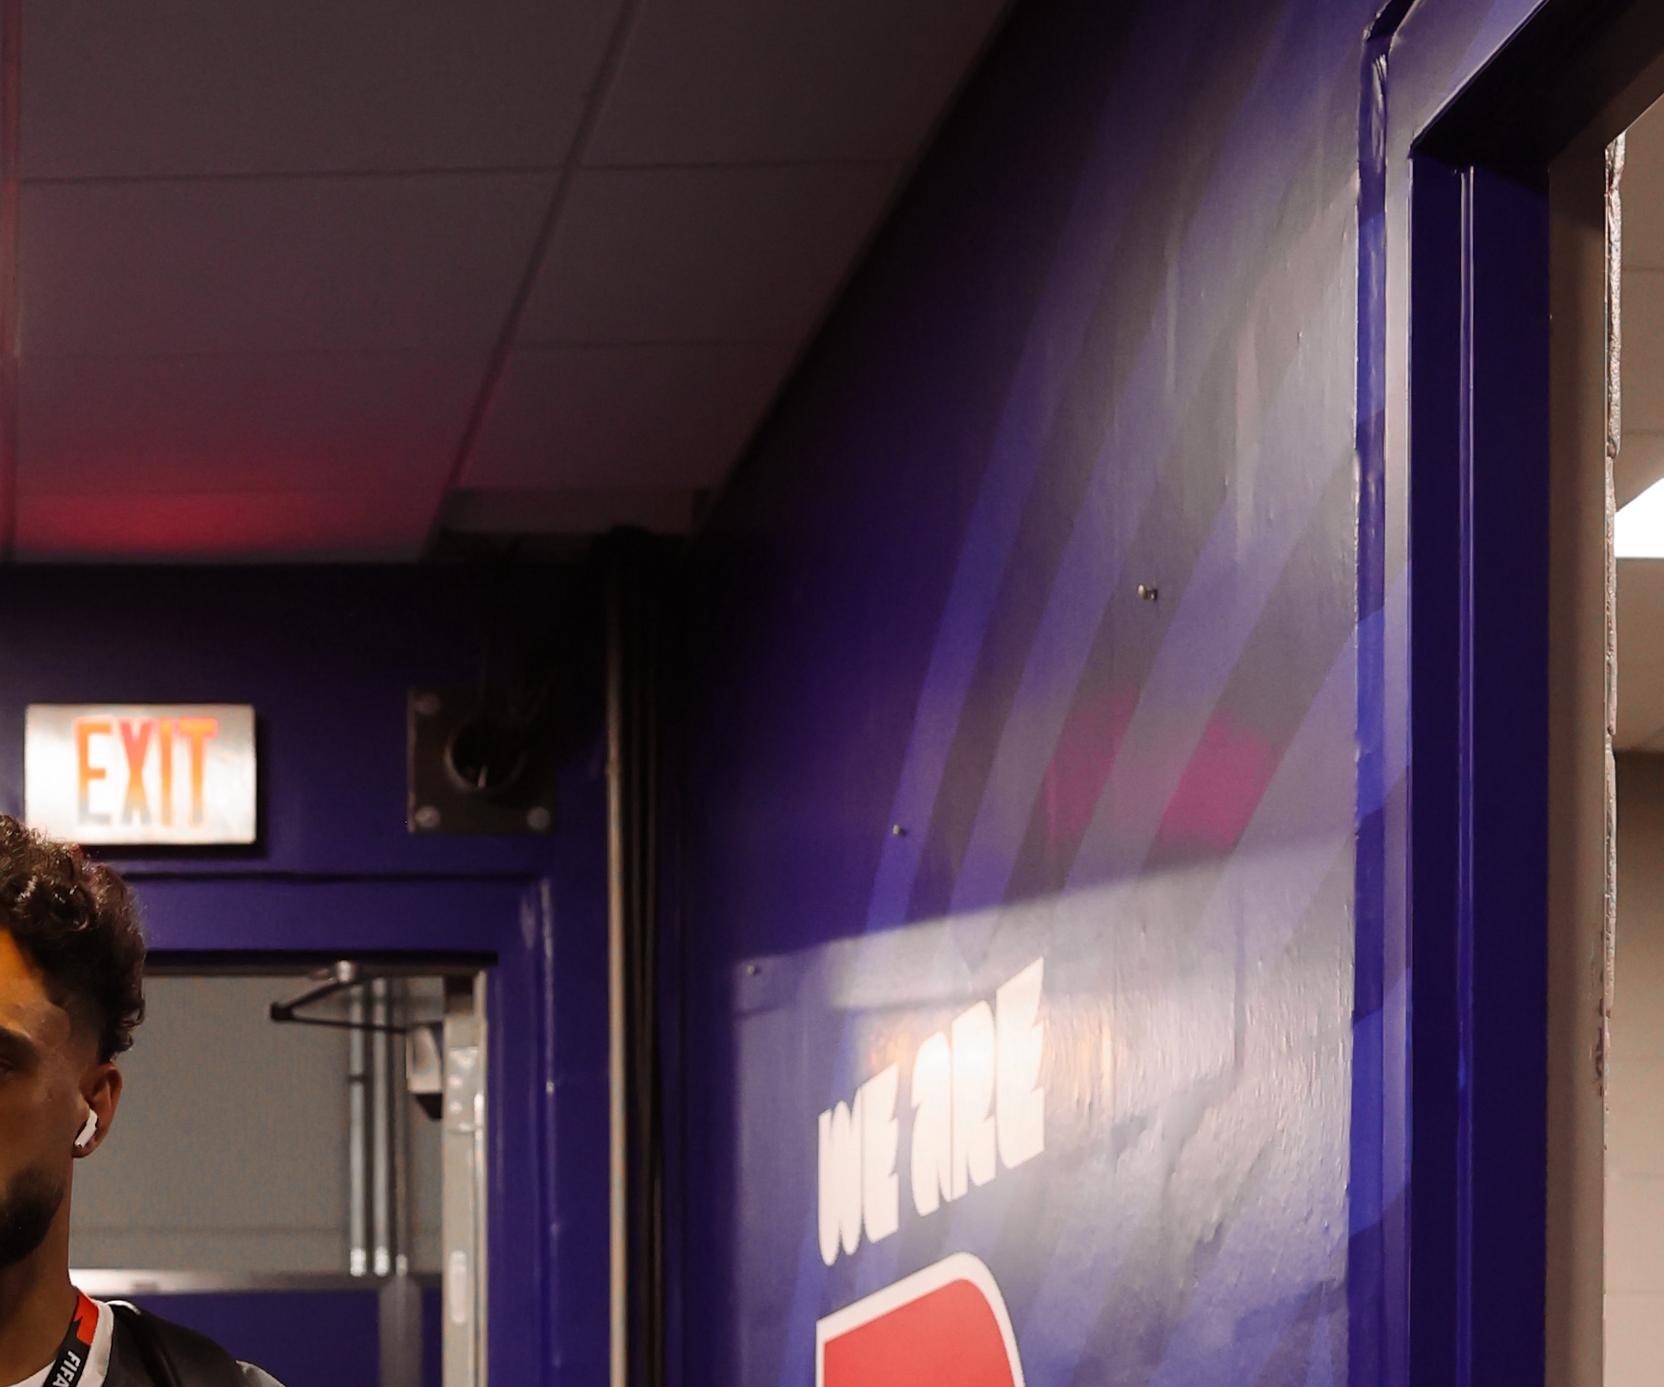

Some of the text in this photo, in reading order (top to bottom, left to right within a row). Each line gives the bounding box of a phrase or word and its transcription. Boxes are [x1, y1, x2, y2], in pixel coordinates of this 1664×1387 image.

[74, 716, 218, 827] EXIT
[817, 956, 1045, 1267] WE ARE
